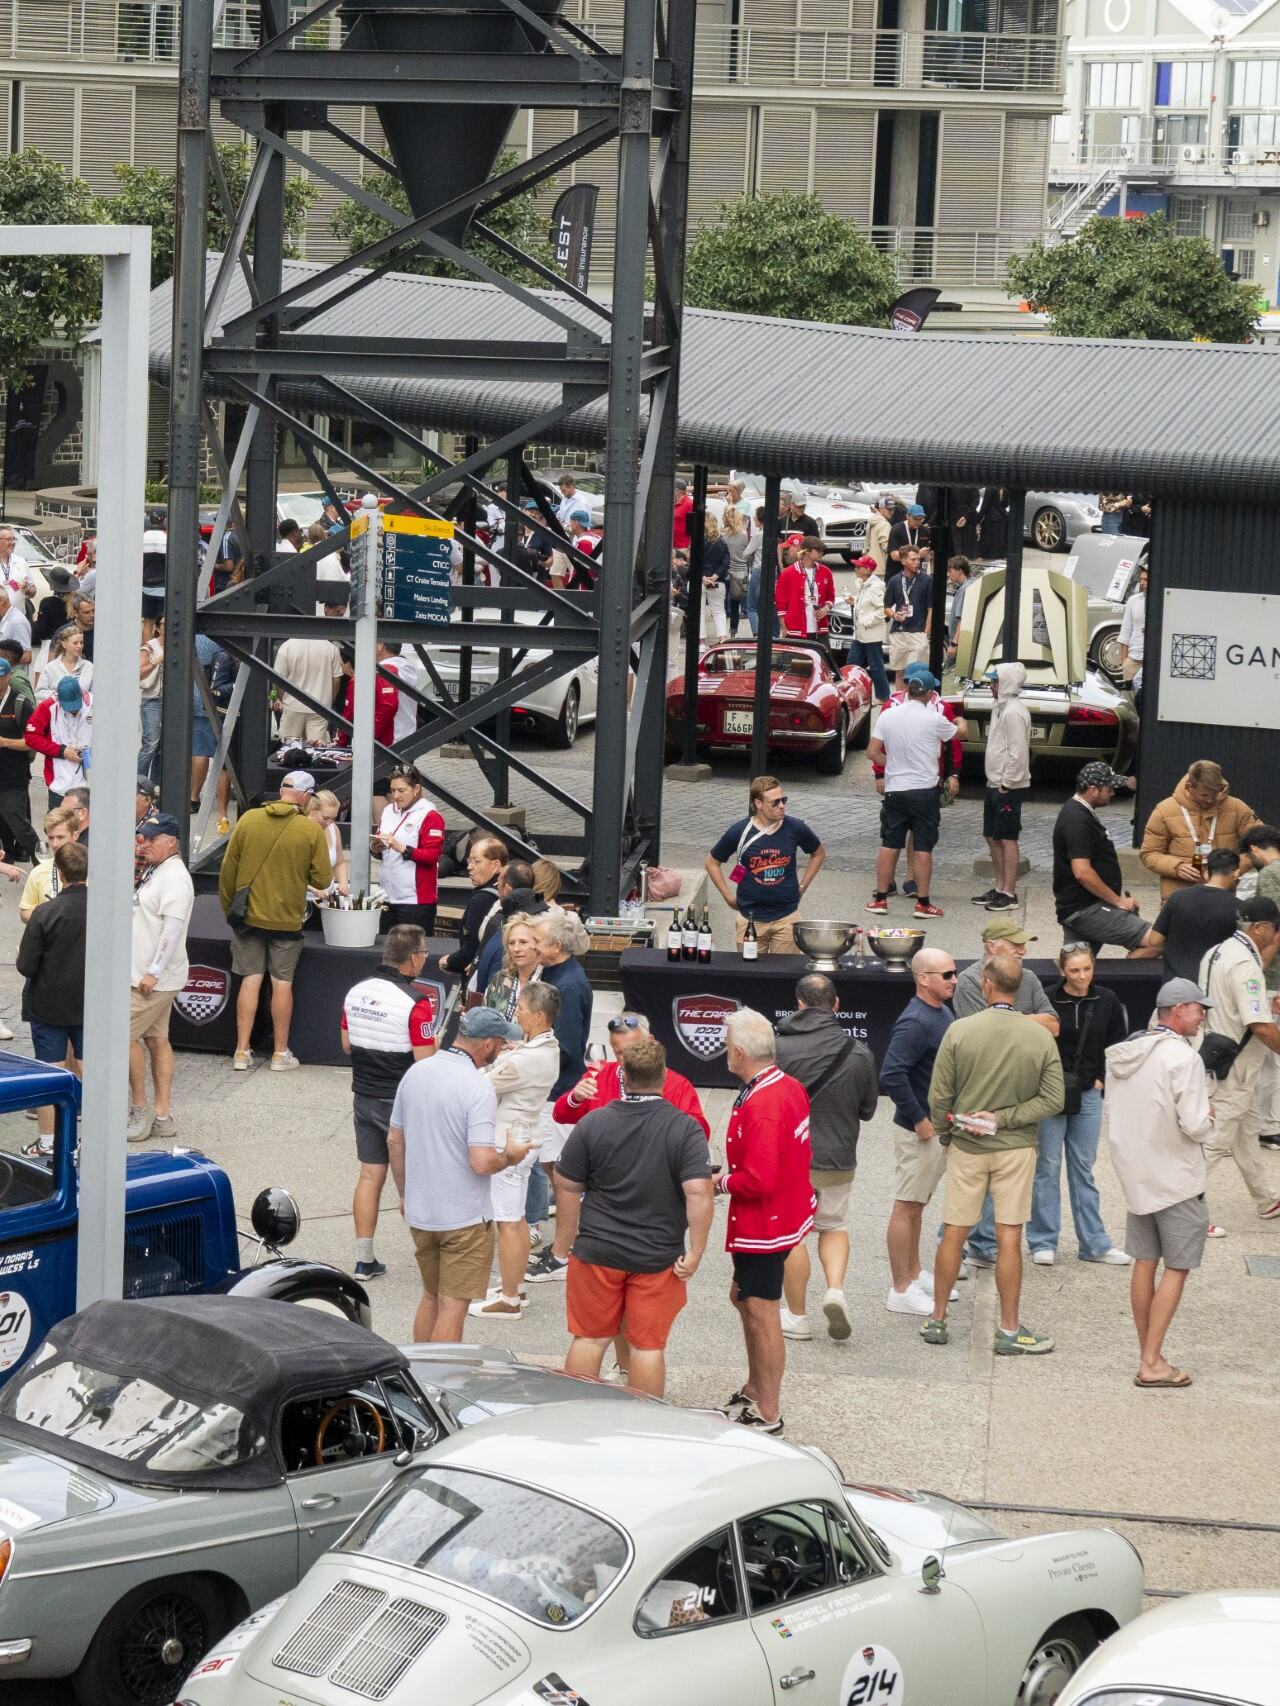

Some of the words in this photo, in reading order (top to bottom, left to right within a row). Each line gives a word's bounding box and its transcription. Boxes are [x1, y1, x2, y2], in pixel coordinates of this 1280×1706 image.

[577, 226, 589, 270] insurance
[439, 544, 450, 553] City
[432, 561, 450, 569] CTICC
[414, 576, 430, 584] Cruise
[430, 577, 449, 587] Terminal
[413, 593, 430, 602] Makers
[430, 596, 448, 606] Landing
[426, 612, 448, 622] MOCAA
[731, 712, 737, 722] F
[767, 853, 792, 866] Cape
[764, 867, 785, 878] 1000
[194, 980, 225, 989] CAPE
[187, 994, 212, 1003] 1000
[679, 1009, 702, 1018] THE
[834, 1011, 853, 1019] YOU
[694, 1026, 722, 1034] 1000
[4, 1249, 34, 1265] NORRIS
[27, 1258, 41, 1270] LS
[683, 1586, 716, 1610] 214
[784, 1604, 828, 1625] MICHAEL
[846, 1668, 898, 1706] 214
